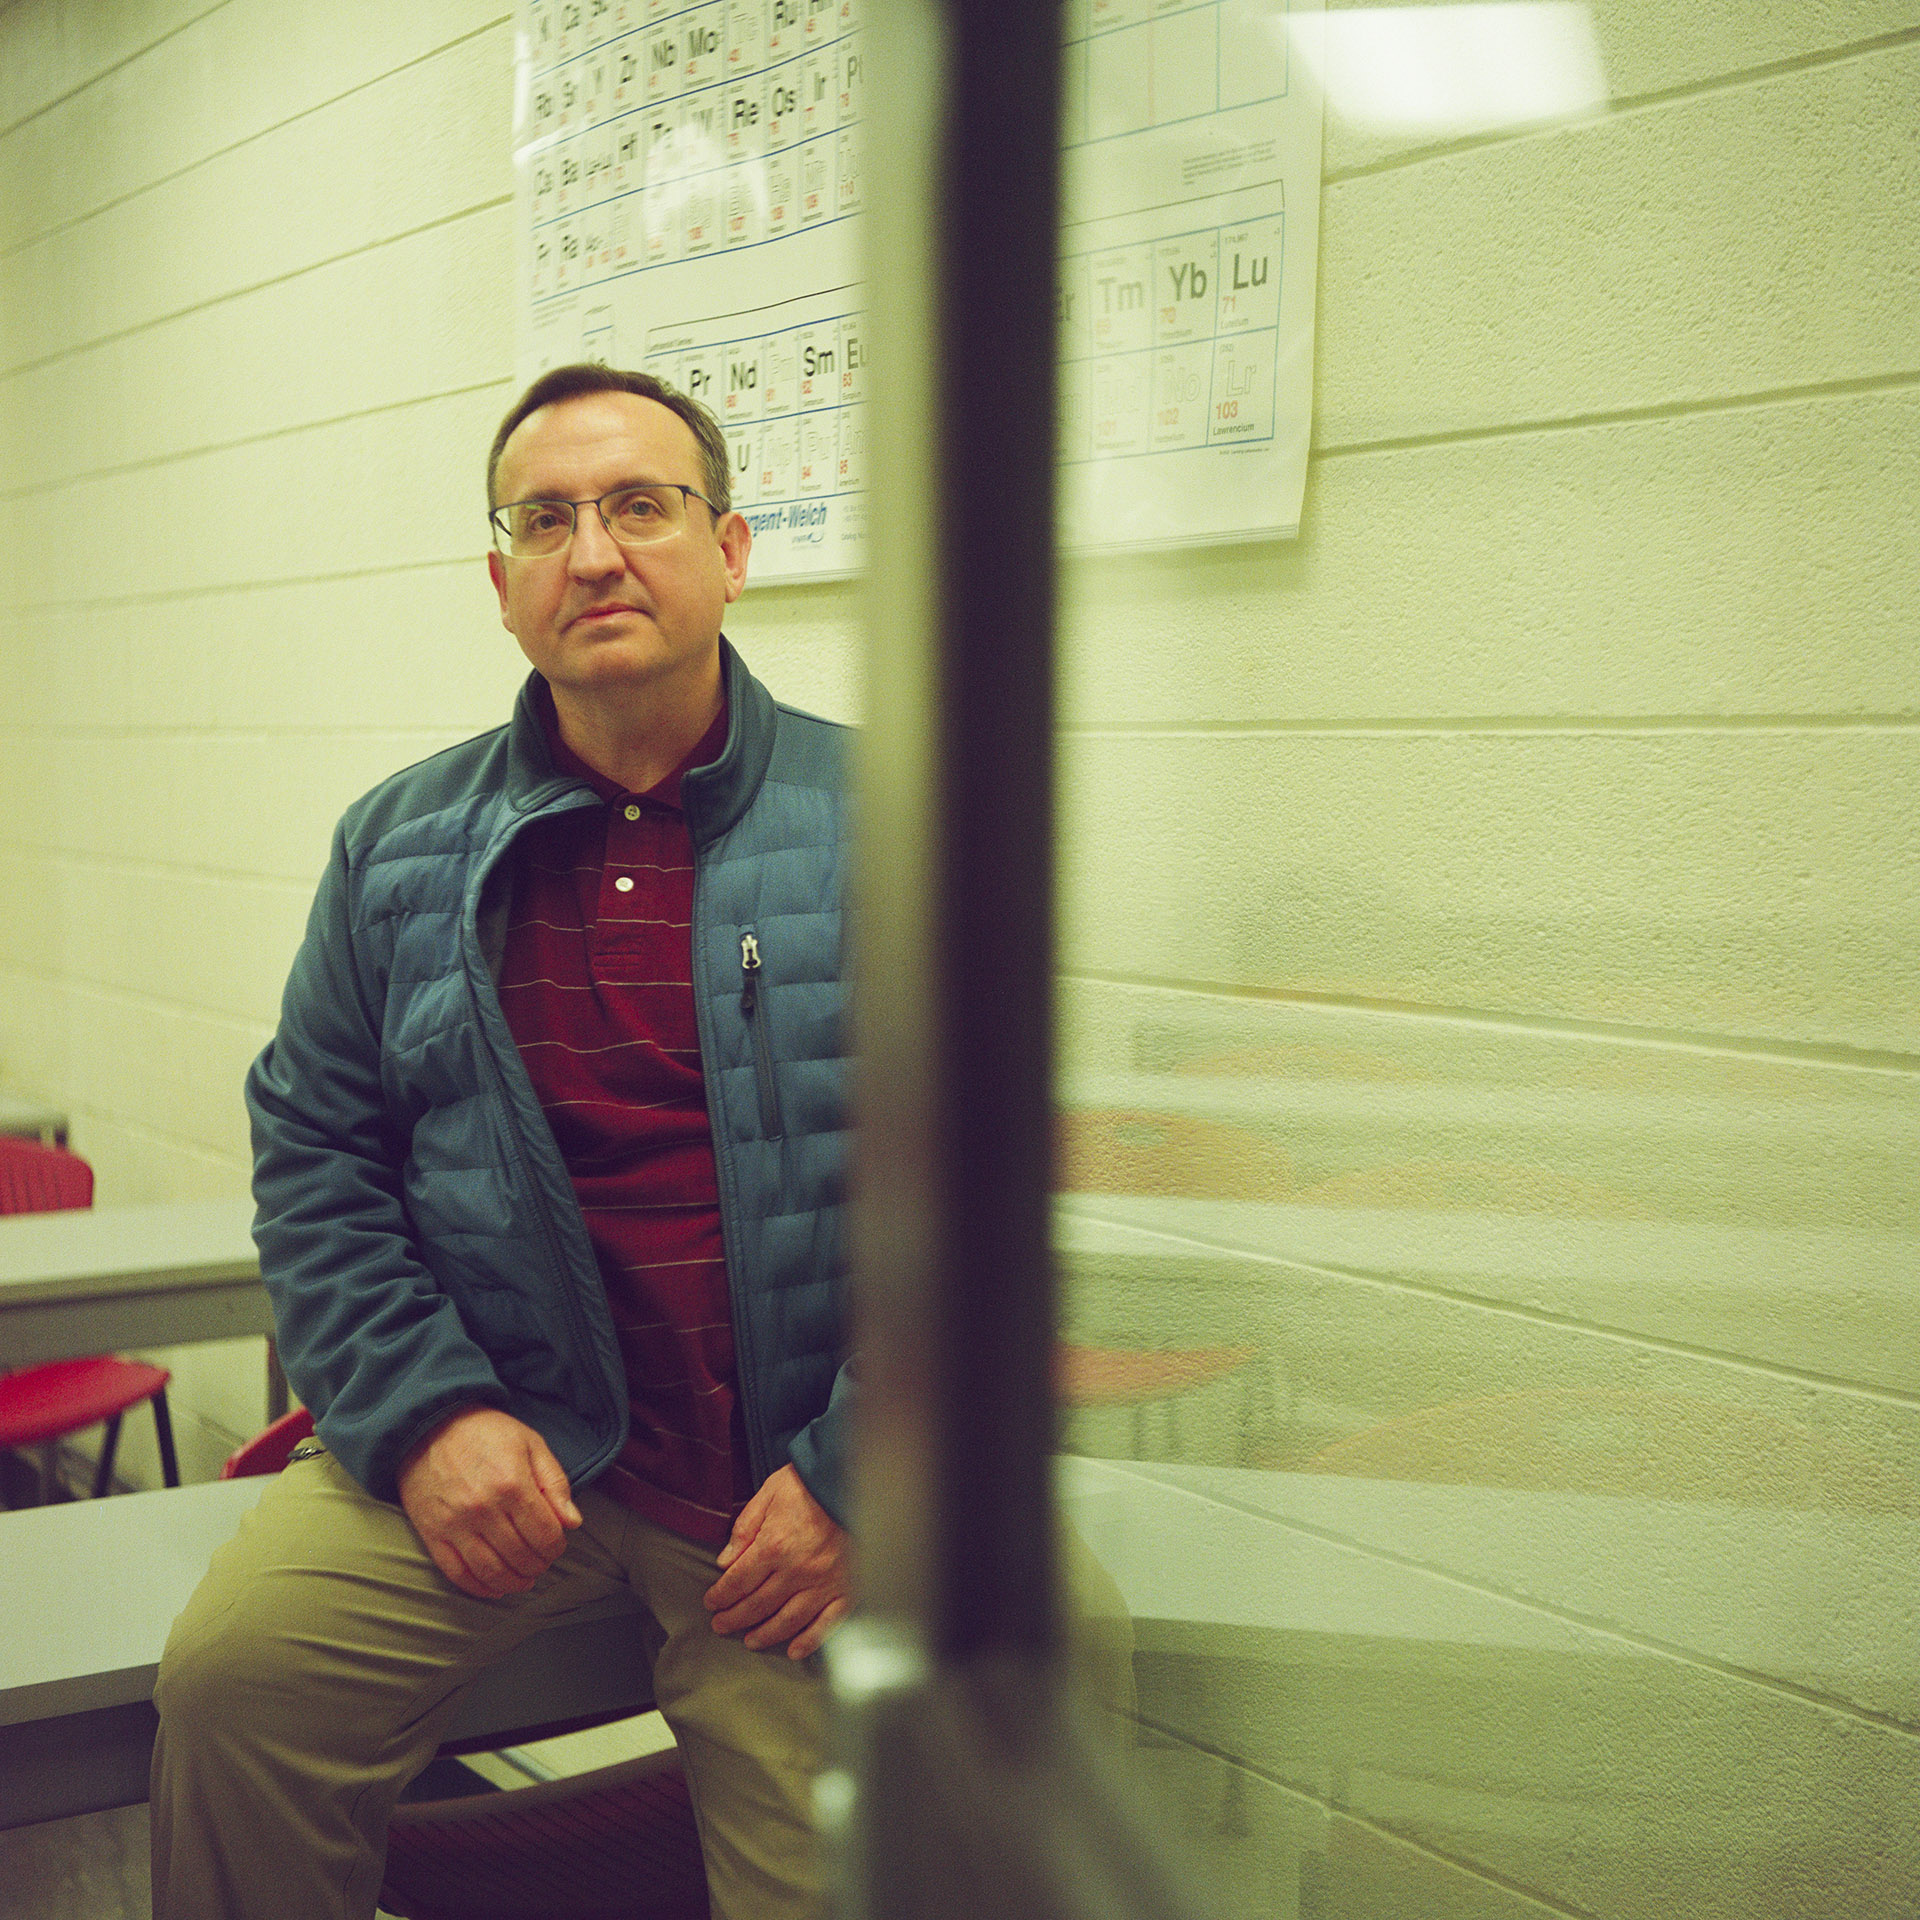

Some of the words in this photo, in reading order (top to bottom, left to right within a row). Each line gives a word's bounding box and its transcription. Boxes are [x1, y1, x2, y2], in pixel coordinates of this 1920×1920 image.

[771, 86, 796, 118] Os
[1168, 261, 1208, 302] Yb
[1232, 253, 1269, 291] Lu
[1096, 276, 1145, 314] Tm
[1222, 295, 1236, 314] 71
[730, 358, 759, 393] Nd
[802, 345, 835, 378] Sm
[689, 368, 712, 398] Pr
[1215, 400, 1239, 420] 103
[1213, 422, 1255, 437] Lawrencium
[737, 443, 751, 472] U
